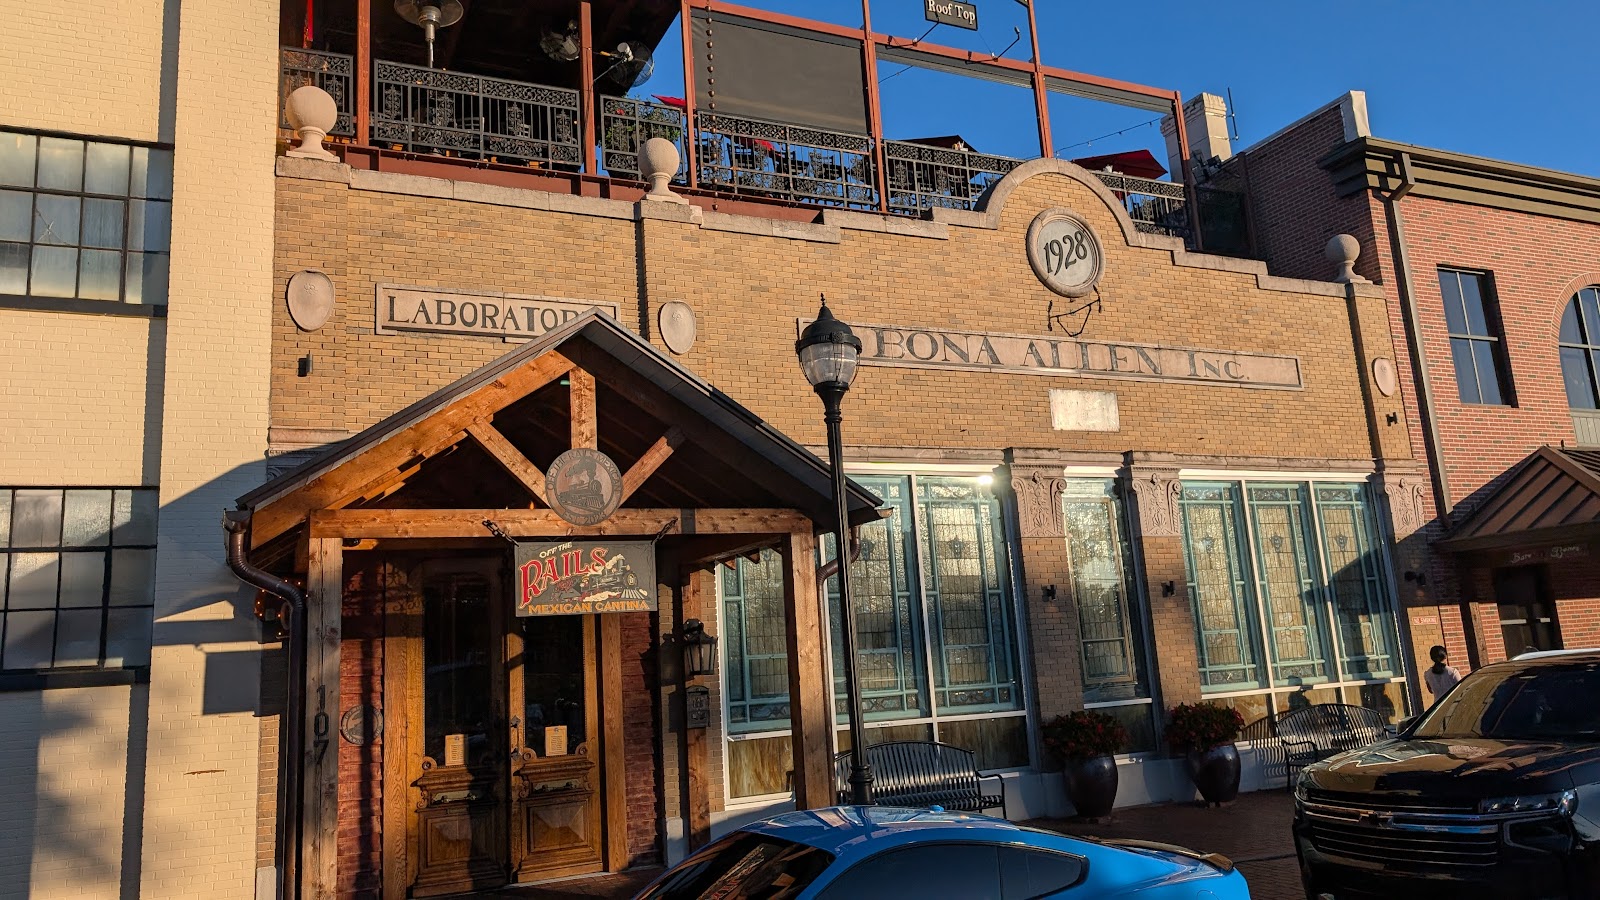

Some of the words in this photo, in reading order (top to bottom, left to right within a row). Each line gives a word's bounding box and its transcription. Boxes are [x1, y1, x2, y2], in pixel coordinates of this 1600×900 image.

[928, 0, 953, 16] Roof
[955, 6, 976, 25] Top
[1043, 230, 1088, 277] 1928
[387, 294, 584, 333] LABORATO
[871, 328, 1004, 366] BONA
[1020, 340, 1163, 375] ALLEN
[539, 546, 557, 559] OFF
[558, 541, 573, 552] THE
[519, 547, 609, 609] RAILS
[528, 602, 592, 615] MEXICAN
[595, 600, 650, 613] CANTINA
[313, 684, 330, 766] 107
